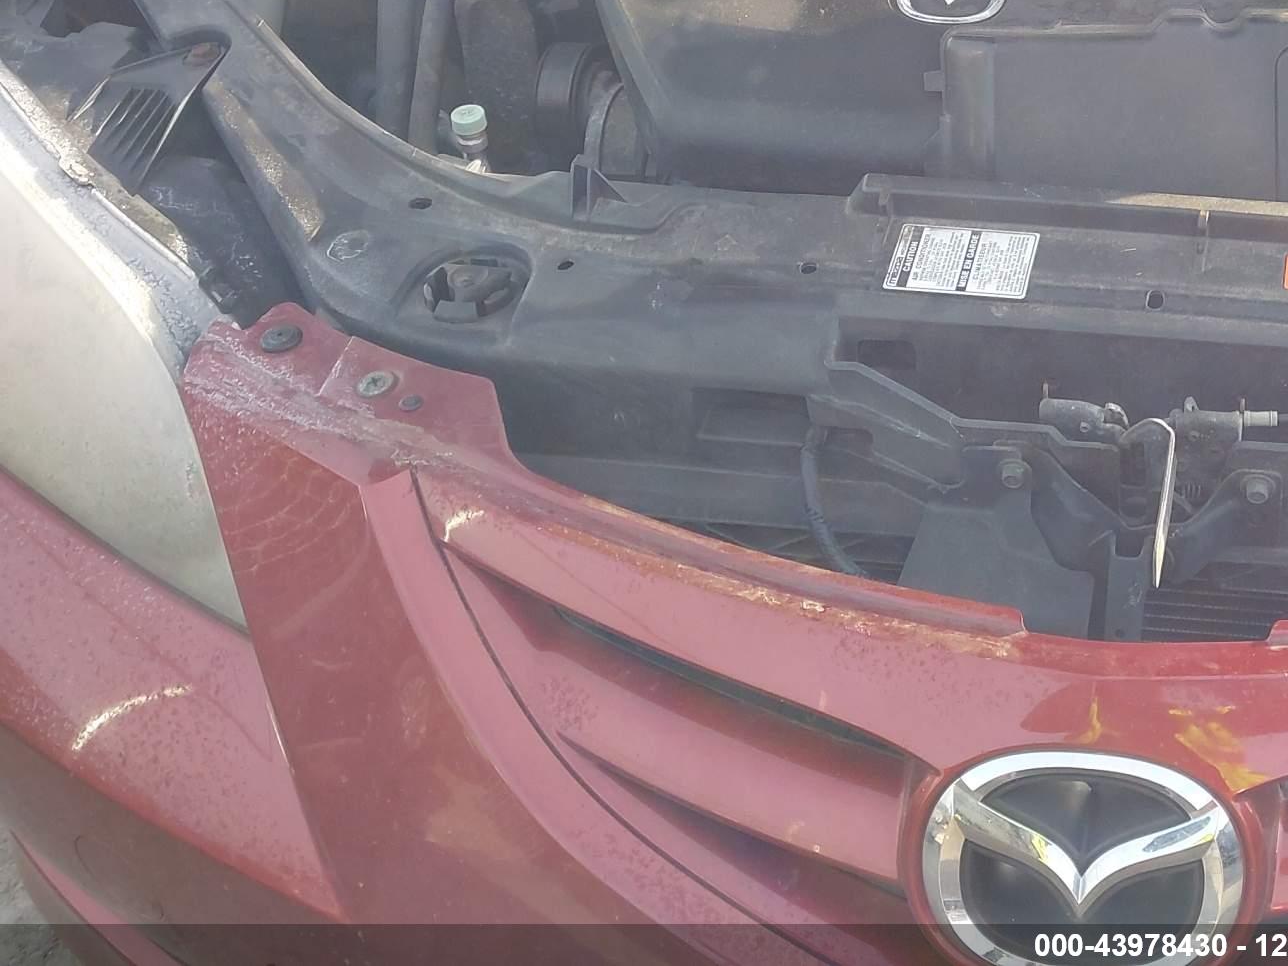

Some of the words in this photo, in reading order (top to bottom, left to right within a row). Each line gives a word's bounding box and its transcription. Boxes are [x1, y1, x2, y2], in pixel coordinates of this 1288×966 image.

[966, 233, 980, 258] GARDE
[903, 241, 919, 272] CAUTION
[963, 259, 972, 270] EN
[957, 270, 969, 288] MISE
